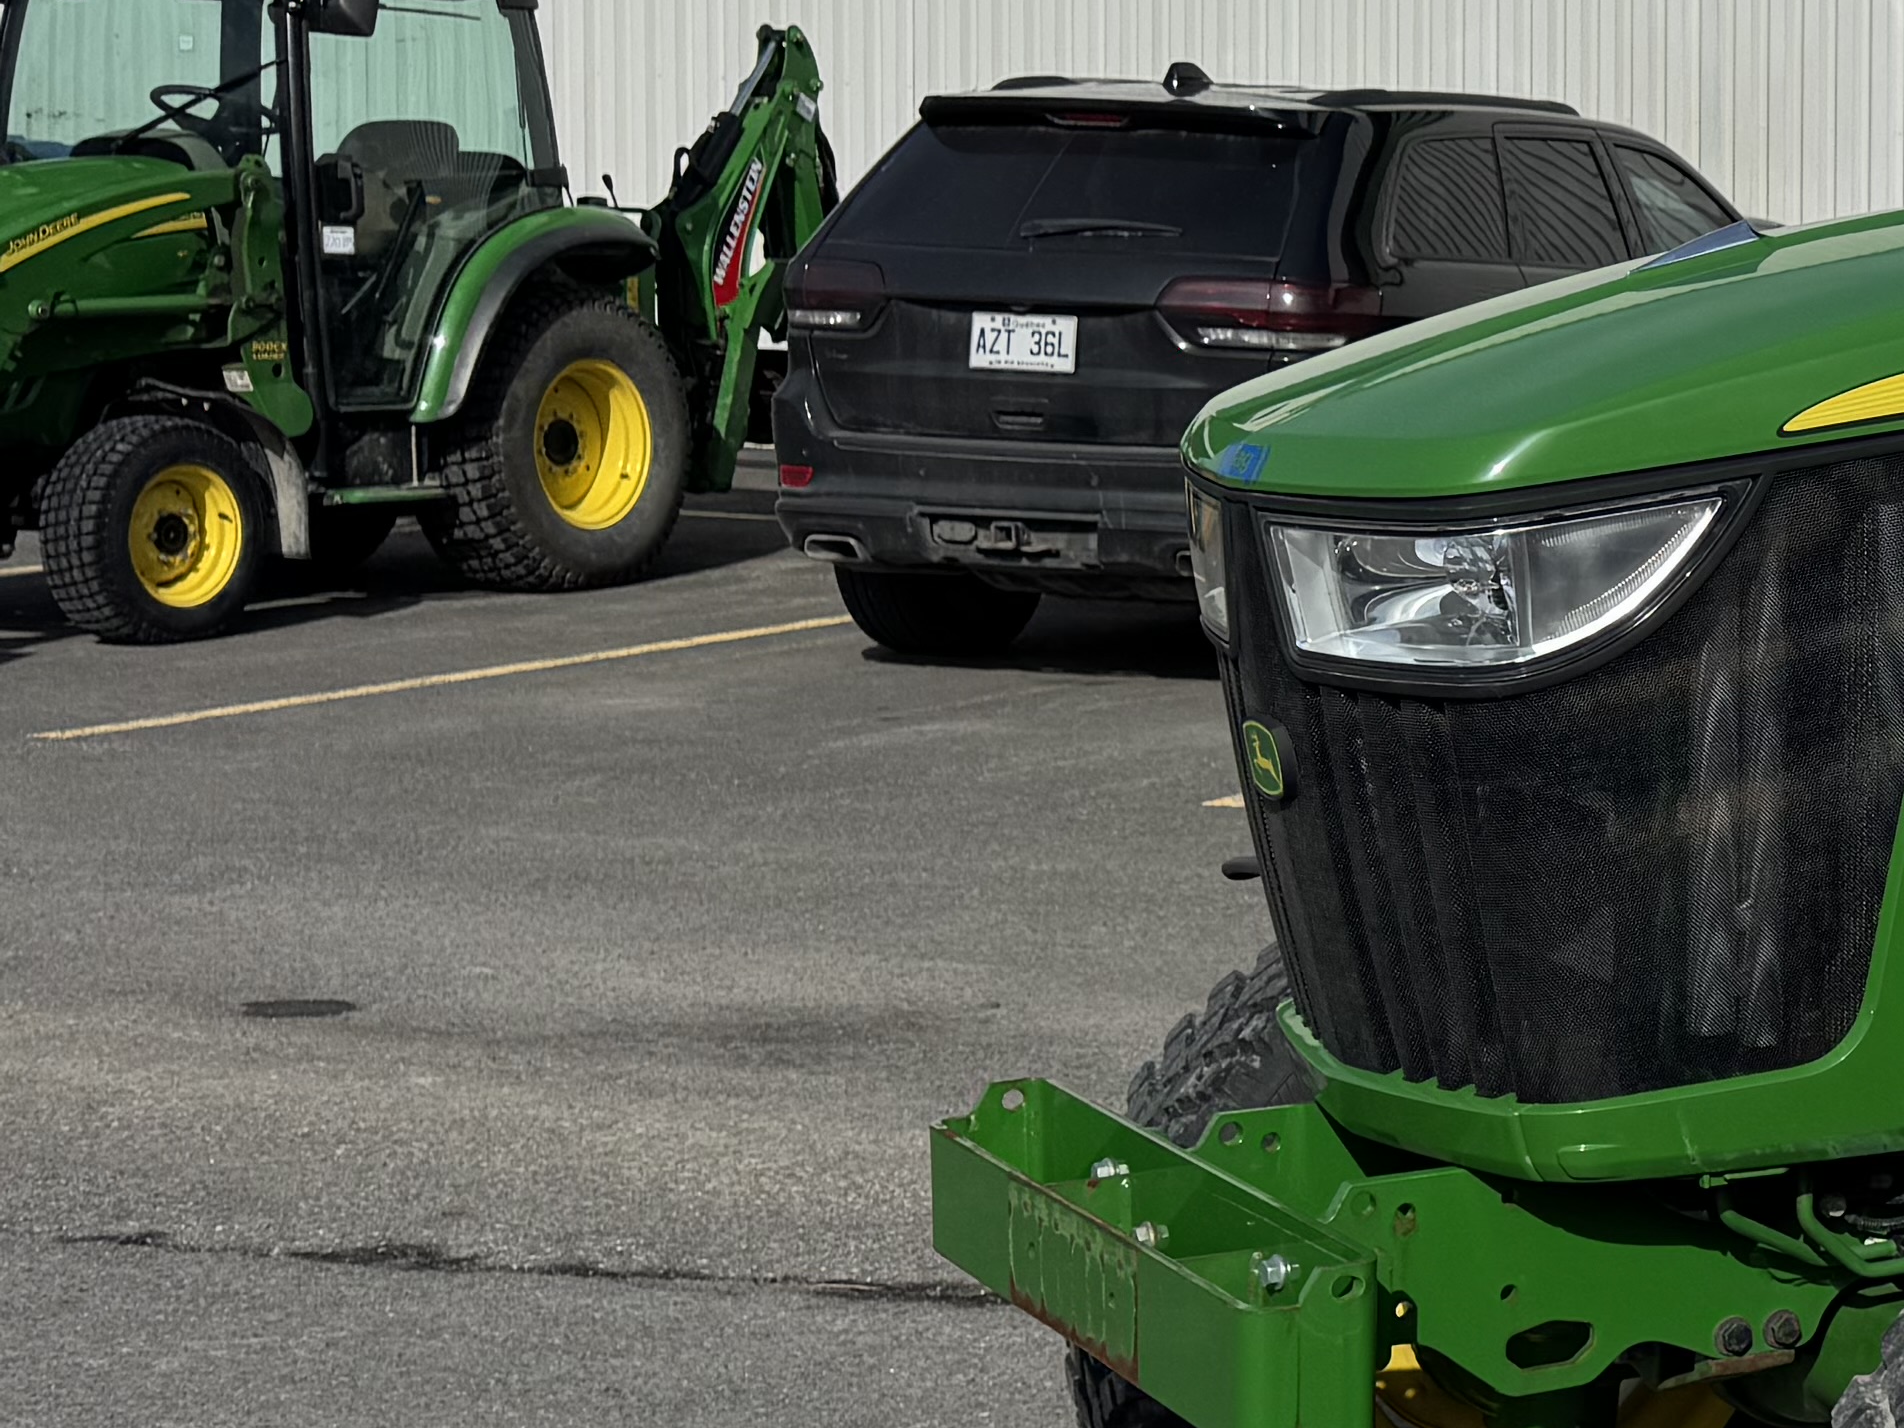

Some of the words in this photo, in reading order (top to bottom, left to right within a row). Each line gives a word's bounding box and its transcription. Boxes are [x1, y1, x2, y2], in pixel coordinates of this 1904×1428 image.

[6, 229, 38, 256] JOHN
[976, 327, 1016, 356] AZT
[1029, 330, 1069, 359] 36L
